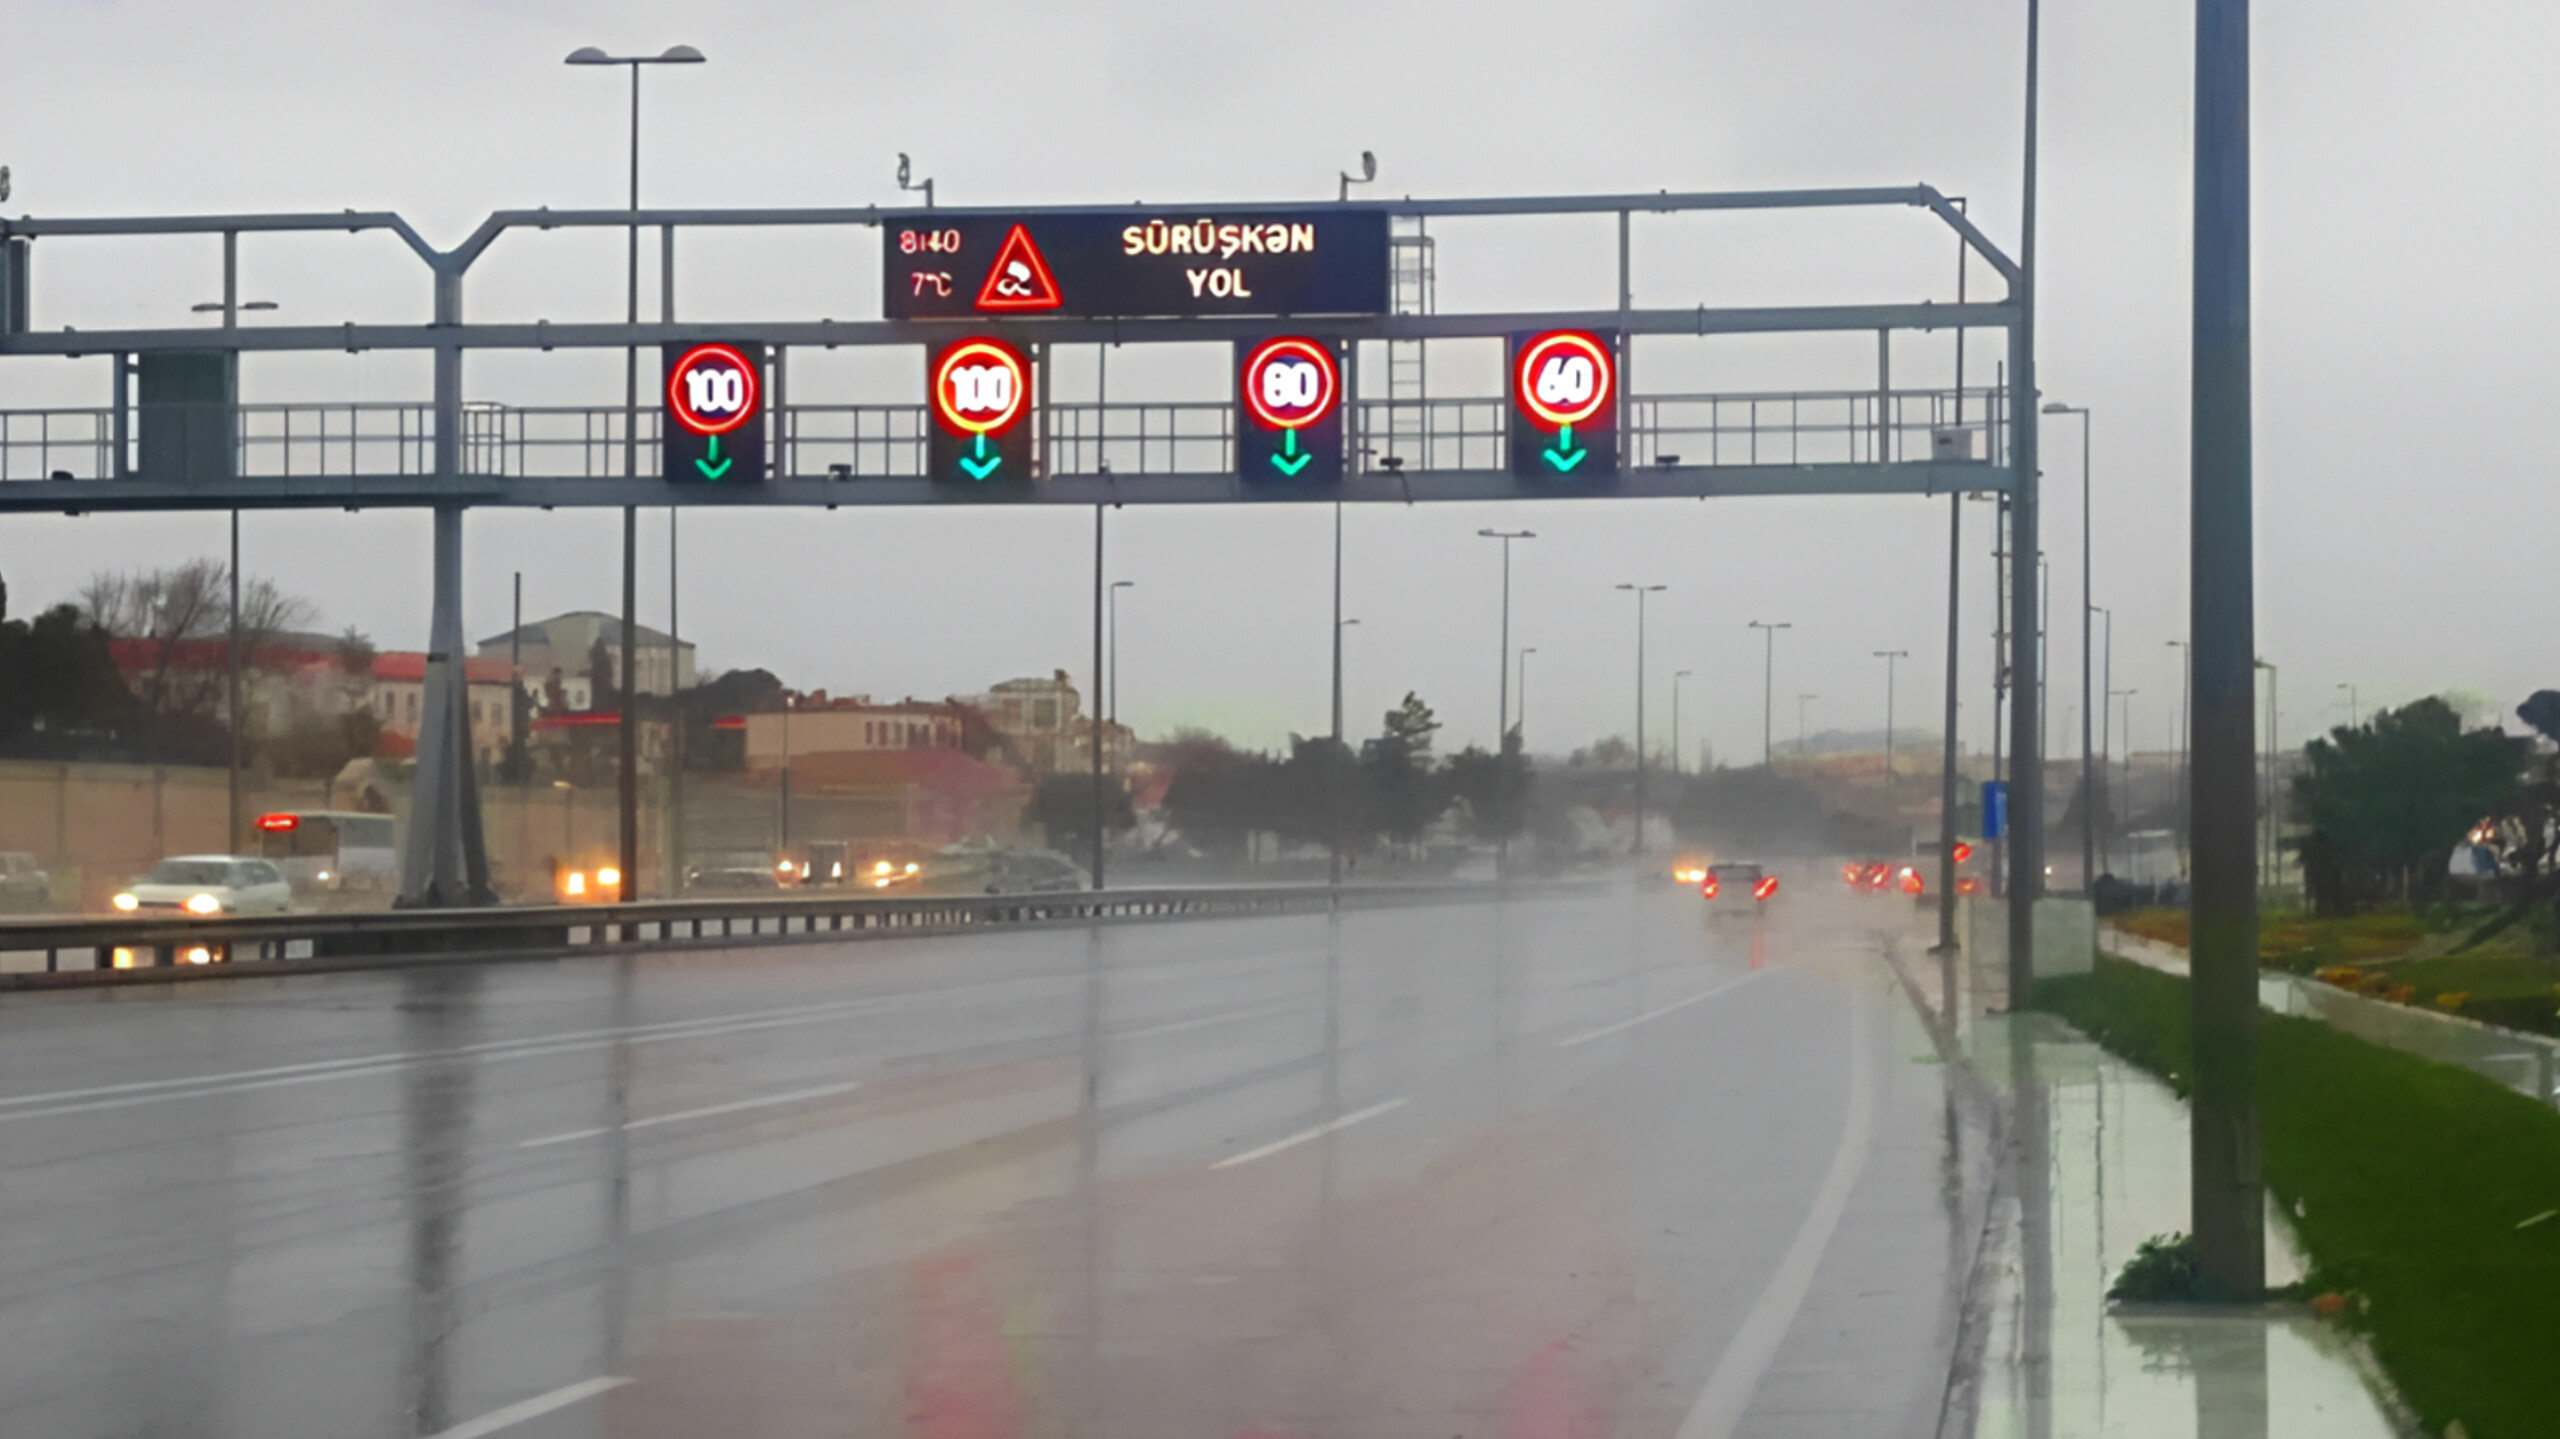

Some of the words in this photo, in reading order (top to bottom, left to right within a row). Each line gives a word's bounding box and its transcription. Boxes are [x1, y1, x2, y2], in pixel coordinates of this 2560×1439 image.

[1186, 268, 1252, 298] YOL
[685, 368, 743, 412] 100
[950, 364, 1011, 412] 100
[1263, 361, 1318, 408] 80
[1537, 356, 1593, 404] 60
